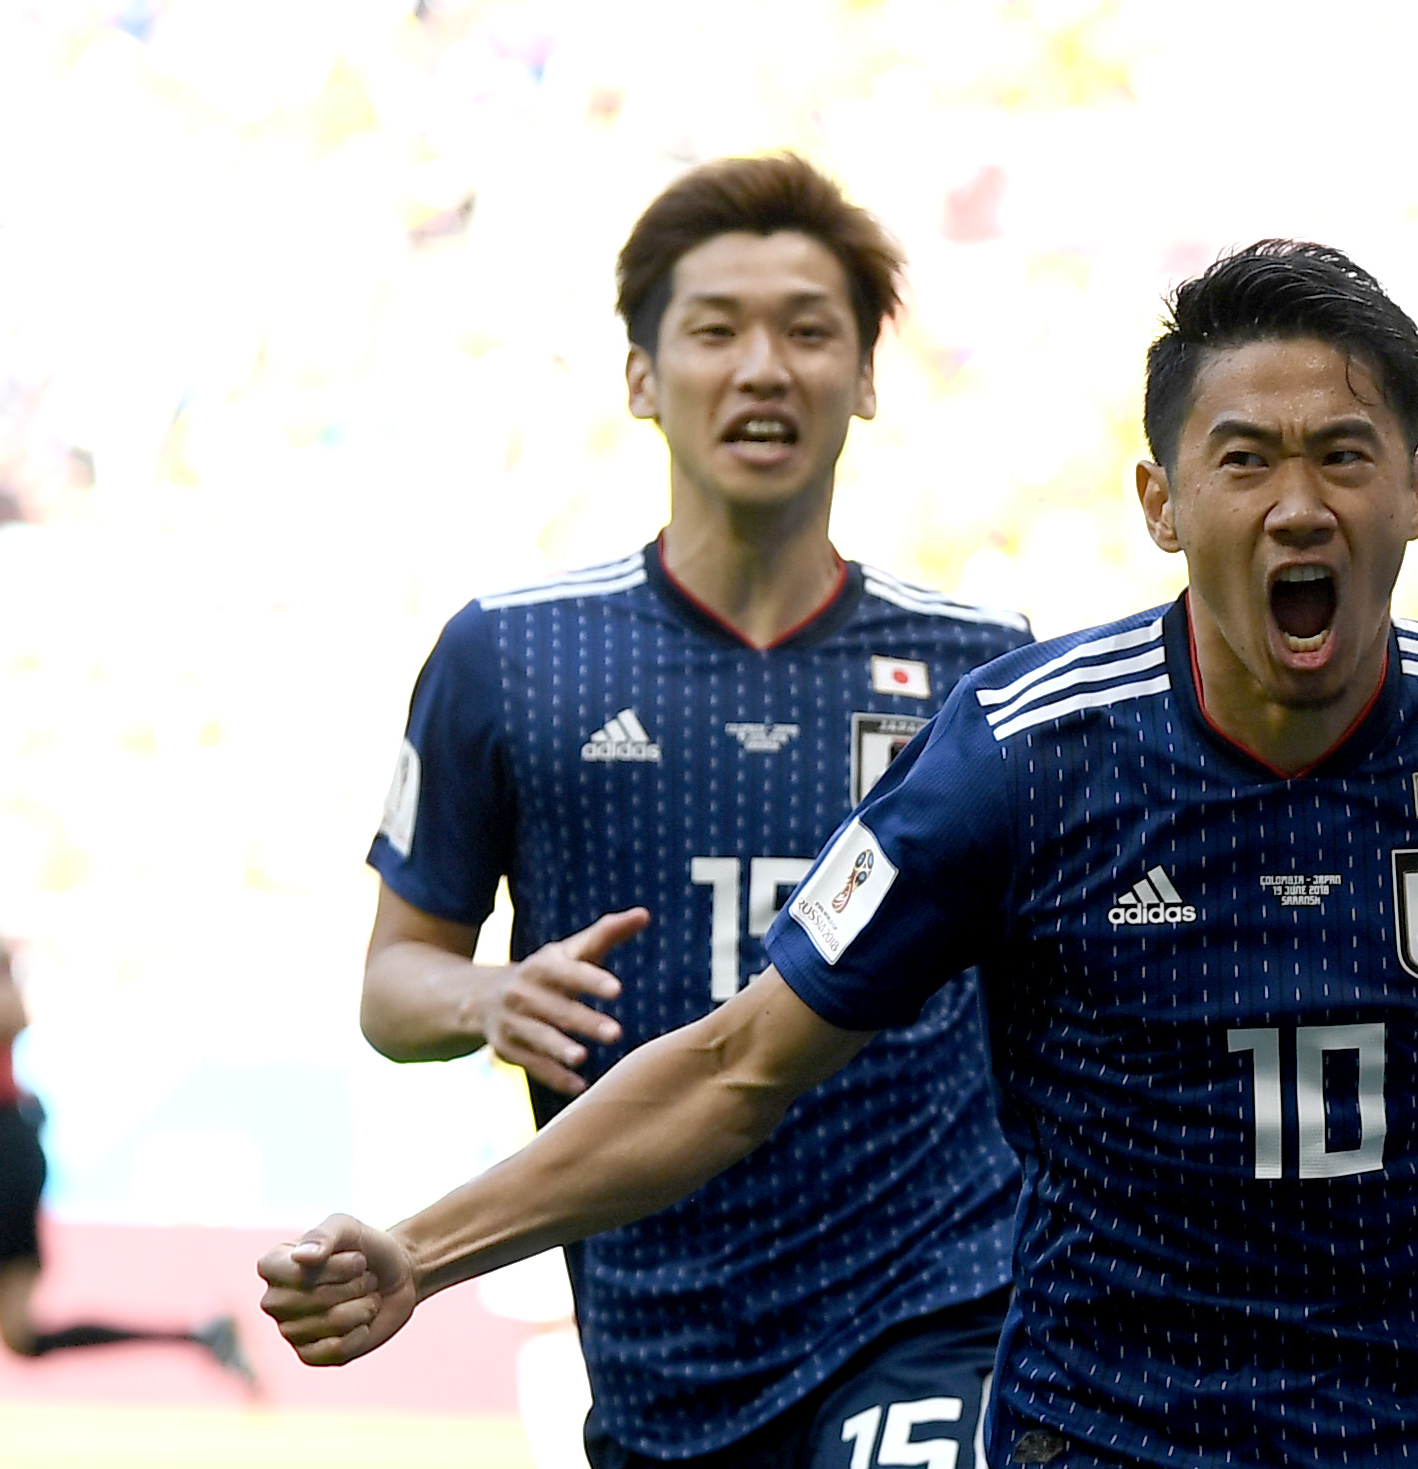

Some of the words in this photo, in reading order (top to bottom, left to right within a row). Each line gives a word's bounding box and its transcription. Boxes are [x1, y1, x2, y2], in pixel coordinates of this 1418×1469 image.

[581, 741, 661, 762] adidas
[1260, 874, 1304, 886] COLOMBIA
[1312, 874, 1342, 885] JAPAN
[1272, 885, 1283, 896] 19
[1283, 885, 1307, 896] JUNE
[1308, 885, 1330, 895] 2018
[1281, 895, 1321, 906] SARANSK
[1108, 902, 1197, 925] adidas
[797, 897, 826, 933] RUSSIA
[822, 927, 840, 953] 2018
[1227, 1022, 1387, 1180] 10
